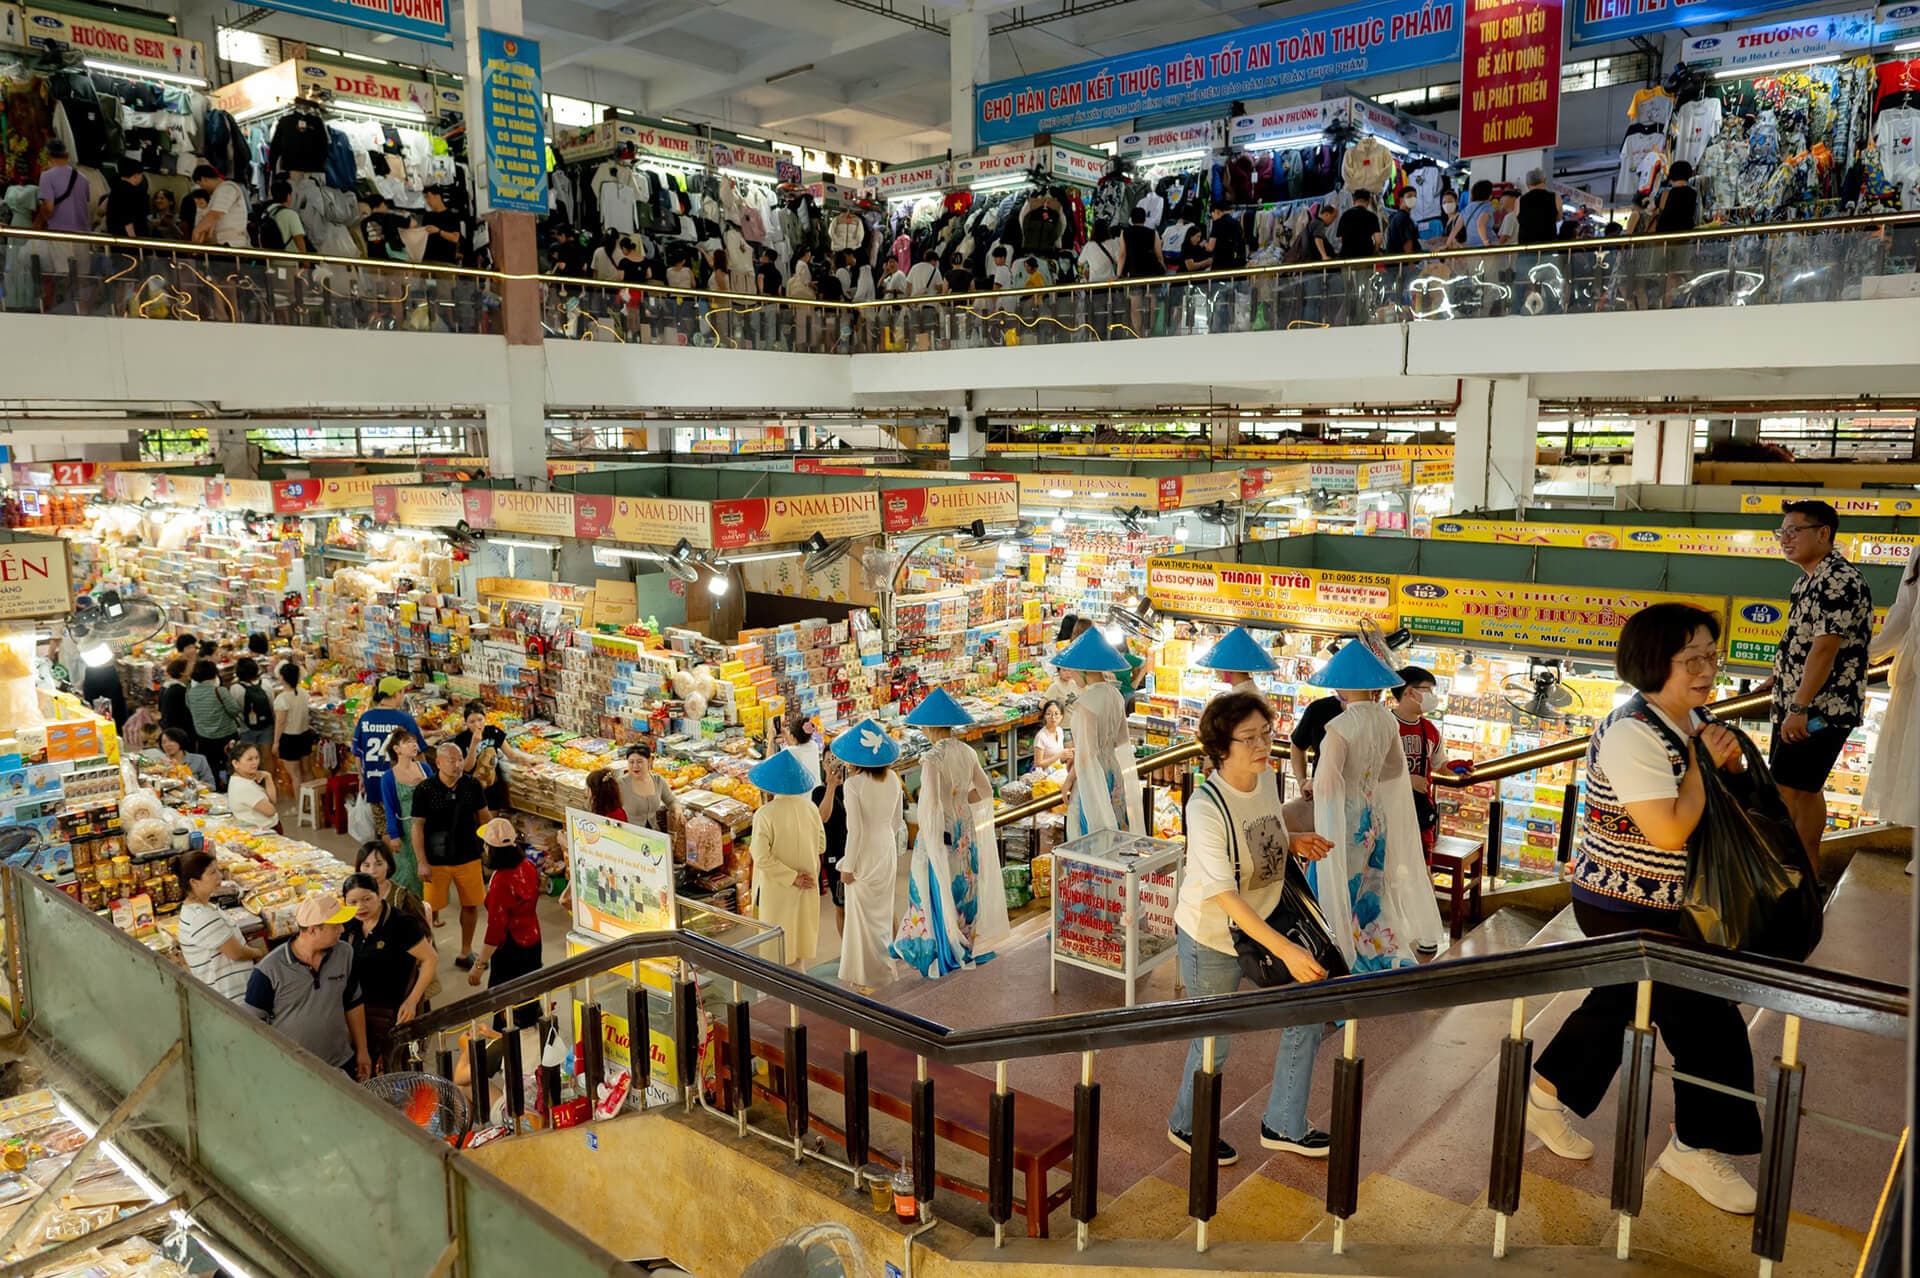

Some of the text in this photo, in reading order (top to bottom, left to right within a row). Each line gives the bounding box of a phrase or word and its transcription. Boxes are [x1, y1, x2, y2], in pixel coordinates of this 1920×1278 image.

[1480, 3, 1545, 44] THU CHỦ YẾU
[71, 25, 129, 53] HƯƠNG
[134, 38, 165, 60] SEN
[1737, 24, 1819, 48] THƯƠNG
[984, 0, 1453, 123] CHỢ HÀN CAM KẾT THỰC HIỆN TỐT AN TOÀN THỰC PHẨM
[1493, 52, 1512, 76] XÂY
[1516, 46, 1545, 73] DỰNG
[334, 75, 401, 102] DIỄM
[1473, 72, 1547, 112] VÀ PHÁT TRIỂN
[1483, 111, 1533, 143] ĐẤT NƯỚC
[638, 130, 690, 152] TỐ MINH
[900, 169, 933, 186] HẠNH
[58, 465, 84, 485] 21
[1325, 465, 1334, 475] 13
[287, 482, 303, 496] 39
[1040, 478, 1129, 489] THU TRANG
[509, 493, 572, 514] SHOP NHI
[790, 494, 876, 517] NAM ĐỊNH
[1834, 500, 1879, 511] LINH
[635, 503, 665, 520] NAM
[668, 504, 705, 524] ĐỊNH
[0, 548, 48, 582] ẾN
[1221, 571, 1262, 585] THANH
[1337, 574, 1356, 582] 0905
[1359, 576, 1373, 584] 215
[1375, 577, 1391, 585] 558
[1413, 590, 1438, 598] 152
[1454, 587, 1488, 597] GIA
[1751, 613, 1771, 623] 151
[1755, 605, 1769, 614] LÔ
[1541, 634, 1566, 645] MỰC
[1738, 626, 1760, 639] CHỢ
[1736, 643, 1777, 653] 0914 01
[1735, 652, 1776, 662] 0931 73
